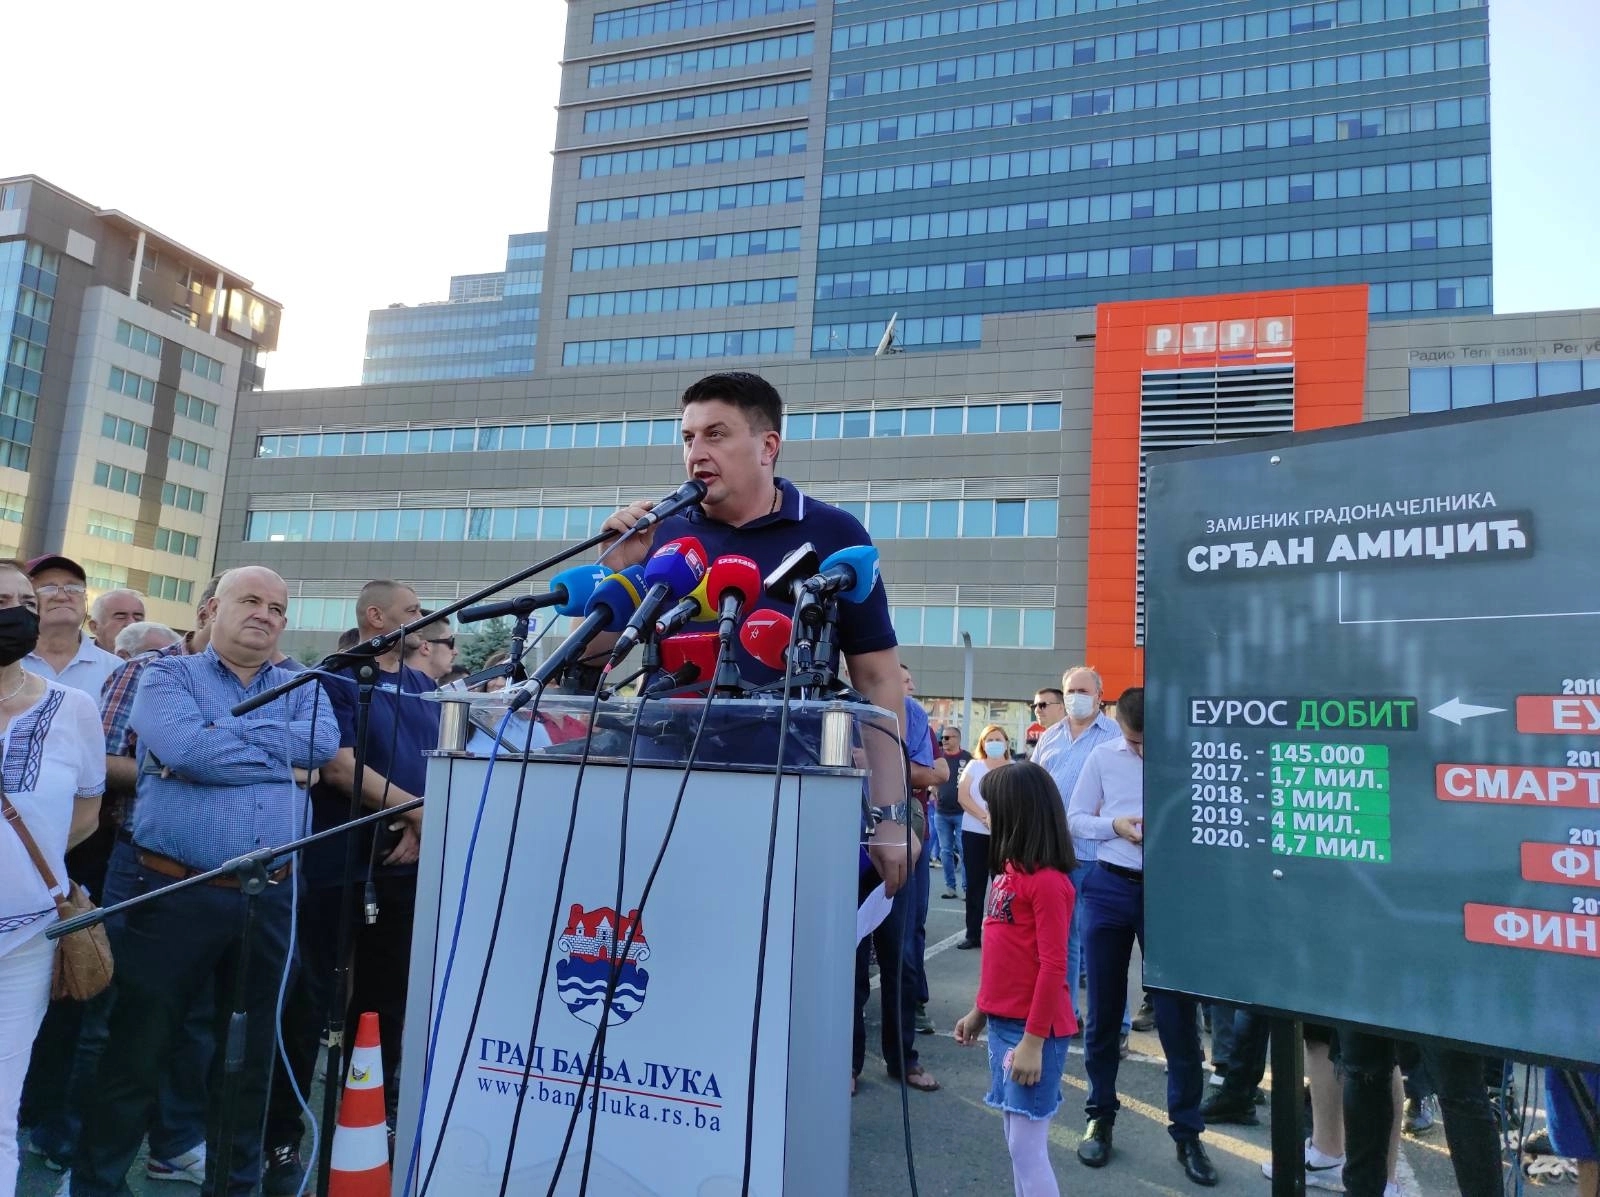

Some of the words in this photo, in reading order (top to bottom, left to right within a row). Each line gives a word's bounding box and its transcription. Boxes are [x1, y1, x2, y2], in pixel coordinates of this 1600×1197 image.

[1155, 320, 1285, 352] РТРС
[1409, 349, 1455, 362] Радио
[1206, 511, 1300, 534] ЗАМЈЕНИК
[1304, 491, 1497, 525] ГРАДОНАЧЕЛНИКА
[1187, 536, 1314, 572] СРЂАН
[1326, 519, 1526, 562] АМИЏИЋ
[1191, 700, 1288, 726] ЕУРОС
[1296, 700, 1415, 731] ДОБИТ
[1552, 699, 1600, 731] ЕУ
[1191, 742, 1249, 761] 2016.
[1271, 744, 1365, 764] 145.000
[1191, 763, 1249, 782] 2017.
[1271, 766, 1306, 787] 1,7
[1314, 768, 1383, 789] МИЛ.
[1443, 767, 1600, 804] СМАРТ
[1191, 784, 1249, 804] 2018.
[1271, 788, 1284, 806] 3
[1292, 790, 1360, 811] МИЛ.
[1191, 805, 1249, 826] 2019.
[1271, 811, 1285, 829] 4
[1293, 812, 1361, 835] МИЛ.
[1191, 826, 1250, 848] 2020.
[1271, 833, 1307, 855] 4,7
[1315, 836, 1385, 860] МИЛ.
[1551, 847, 1600, 881] Ф
[1572, 896, 1600, 915] 20
[1493, 911, 1597, 952] ФИН
[479, 1037, 545, 1076] ГРАД
[551, 1048, 633, 1084] БАЊА
[637, 1062, 723, 1098] ЛУКА
